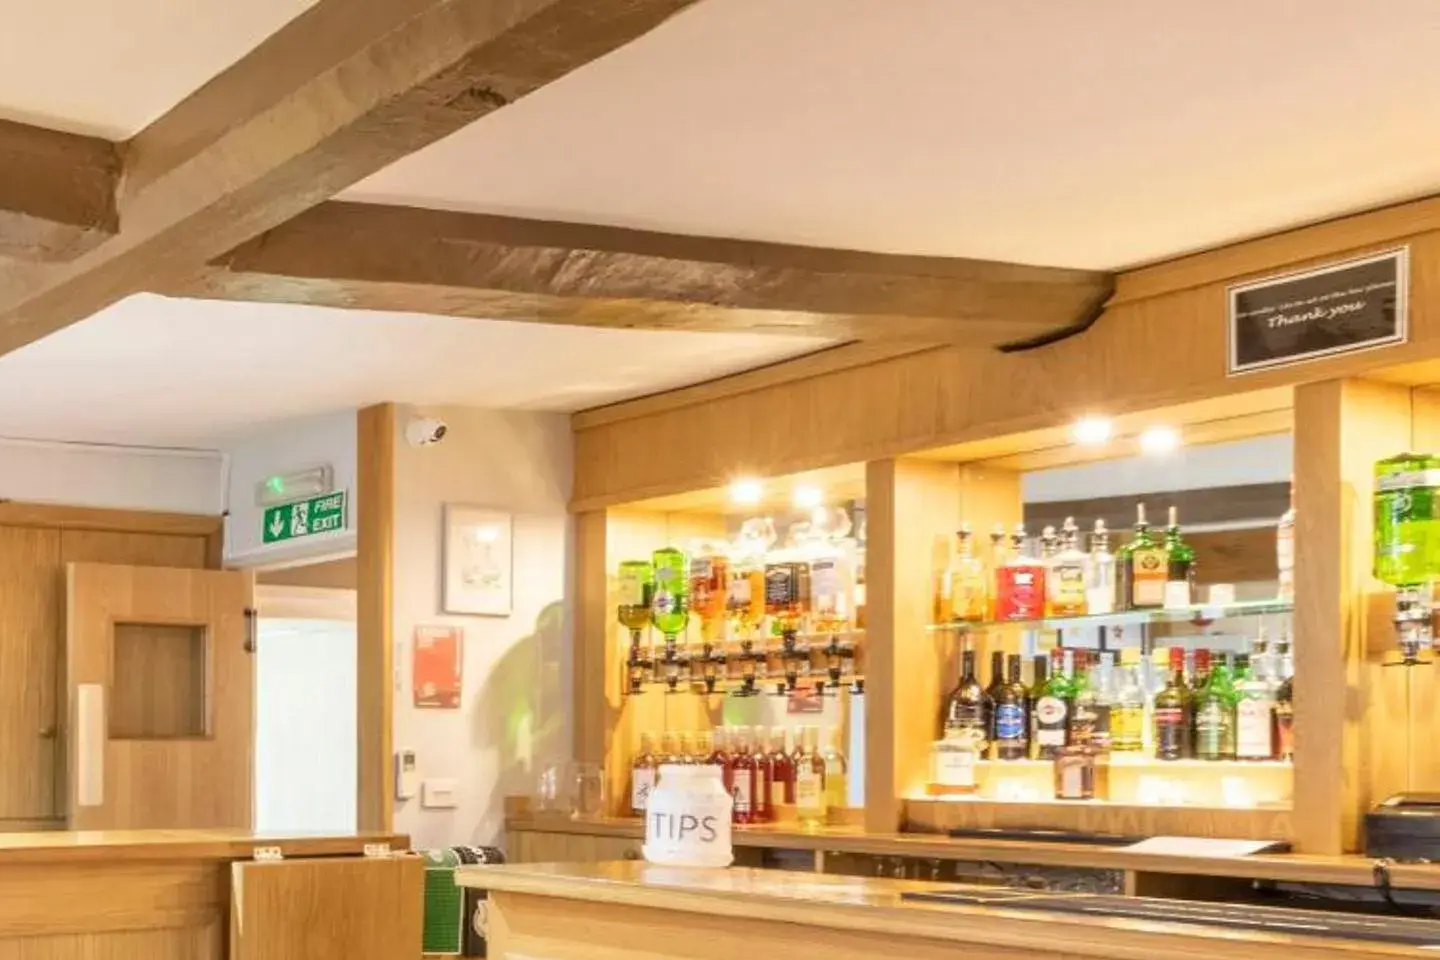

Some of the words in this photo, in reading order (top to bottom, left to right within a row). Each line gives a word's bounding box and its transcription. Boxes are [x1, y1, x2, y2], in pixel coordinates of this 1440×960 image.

[1267, 305, 1328, 329] Thank
[1328, 300, 1367, 320] you
[314, 495, 342, 513] FIRE
[312, 514, 340, 531] EXIT
[652, 813, 718, 842] TIPS
